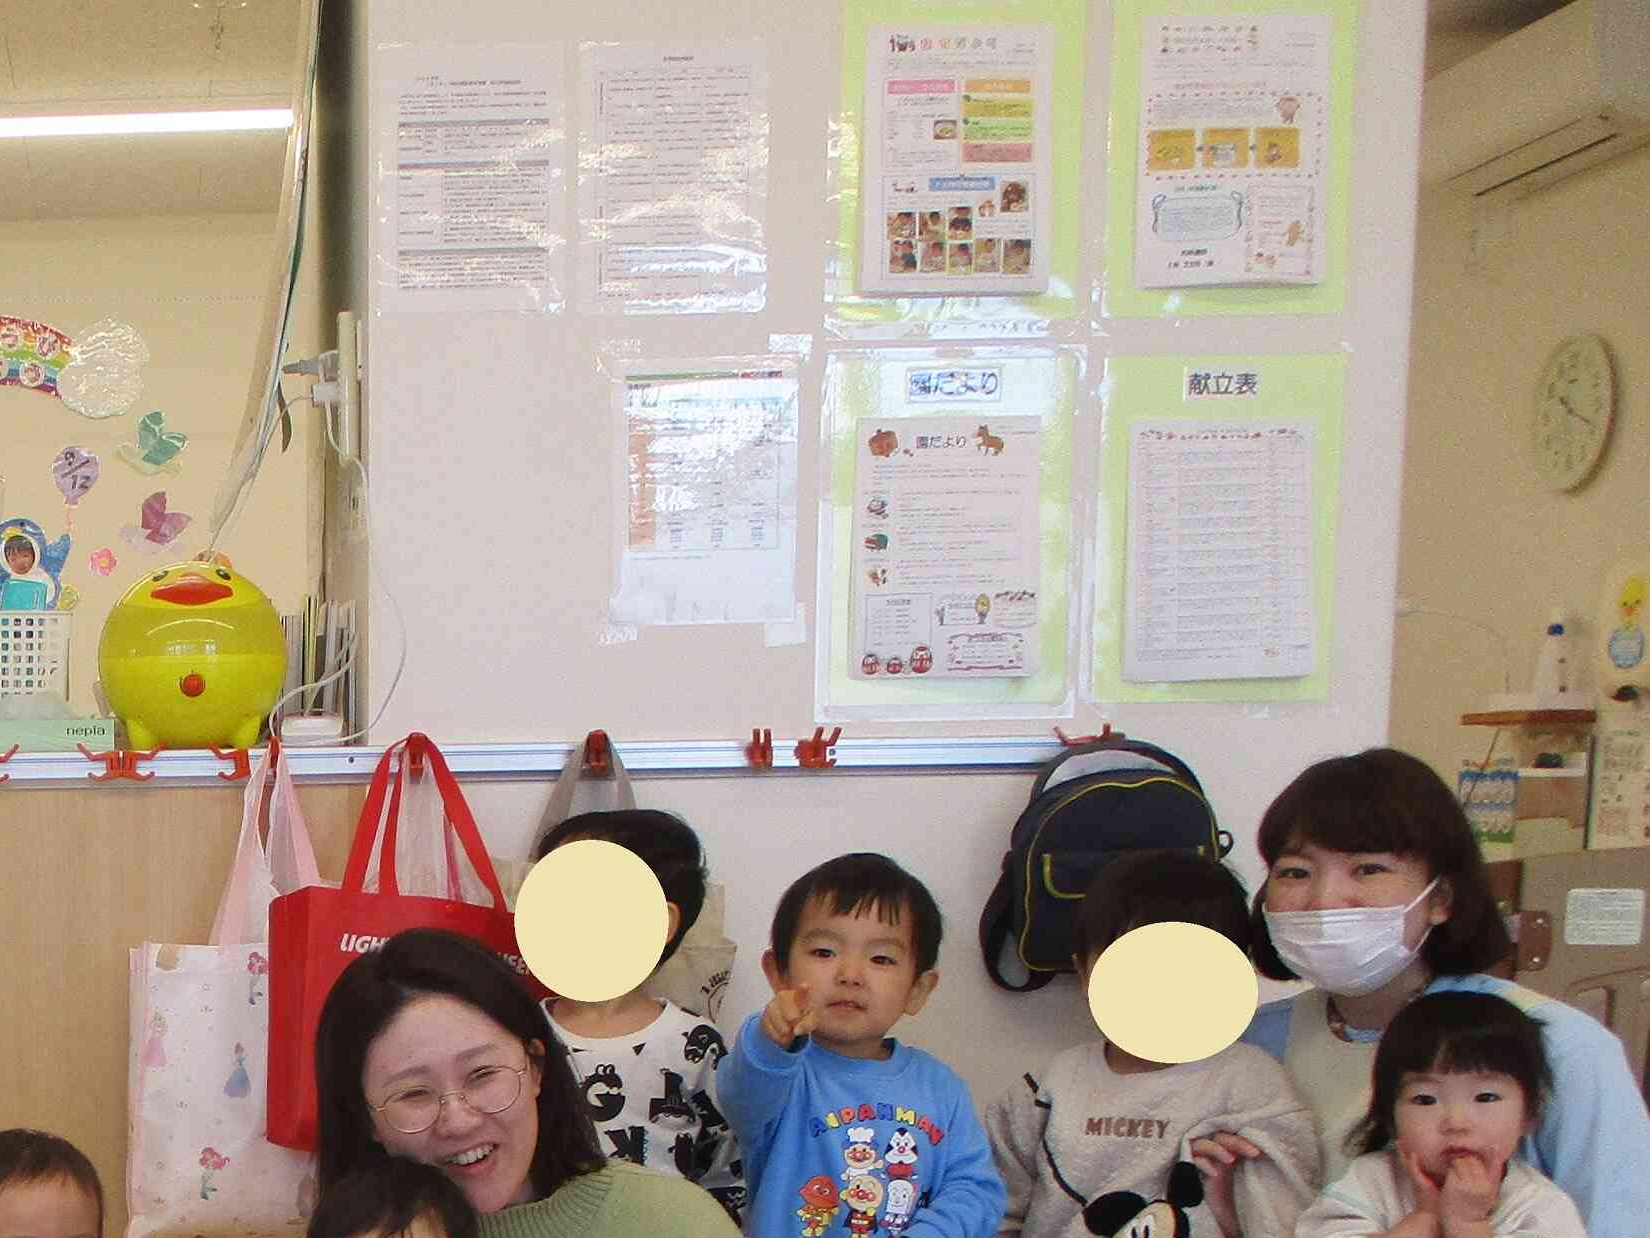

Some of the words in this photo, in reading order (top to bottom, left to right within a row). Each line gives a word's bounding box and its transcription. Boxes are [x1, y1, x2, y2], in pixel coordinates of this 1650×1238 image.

[1188, 372, 1258, 395] 献立表
[66, 725, 106, 738] nepia
[340, 933, 390, 954] LIGH
[1085, 1117, 1172, 1139] MICKEY
